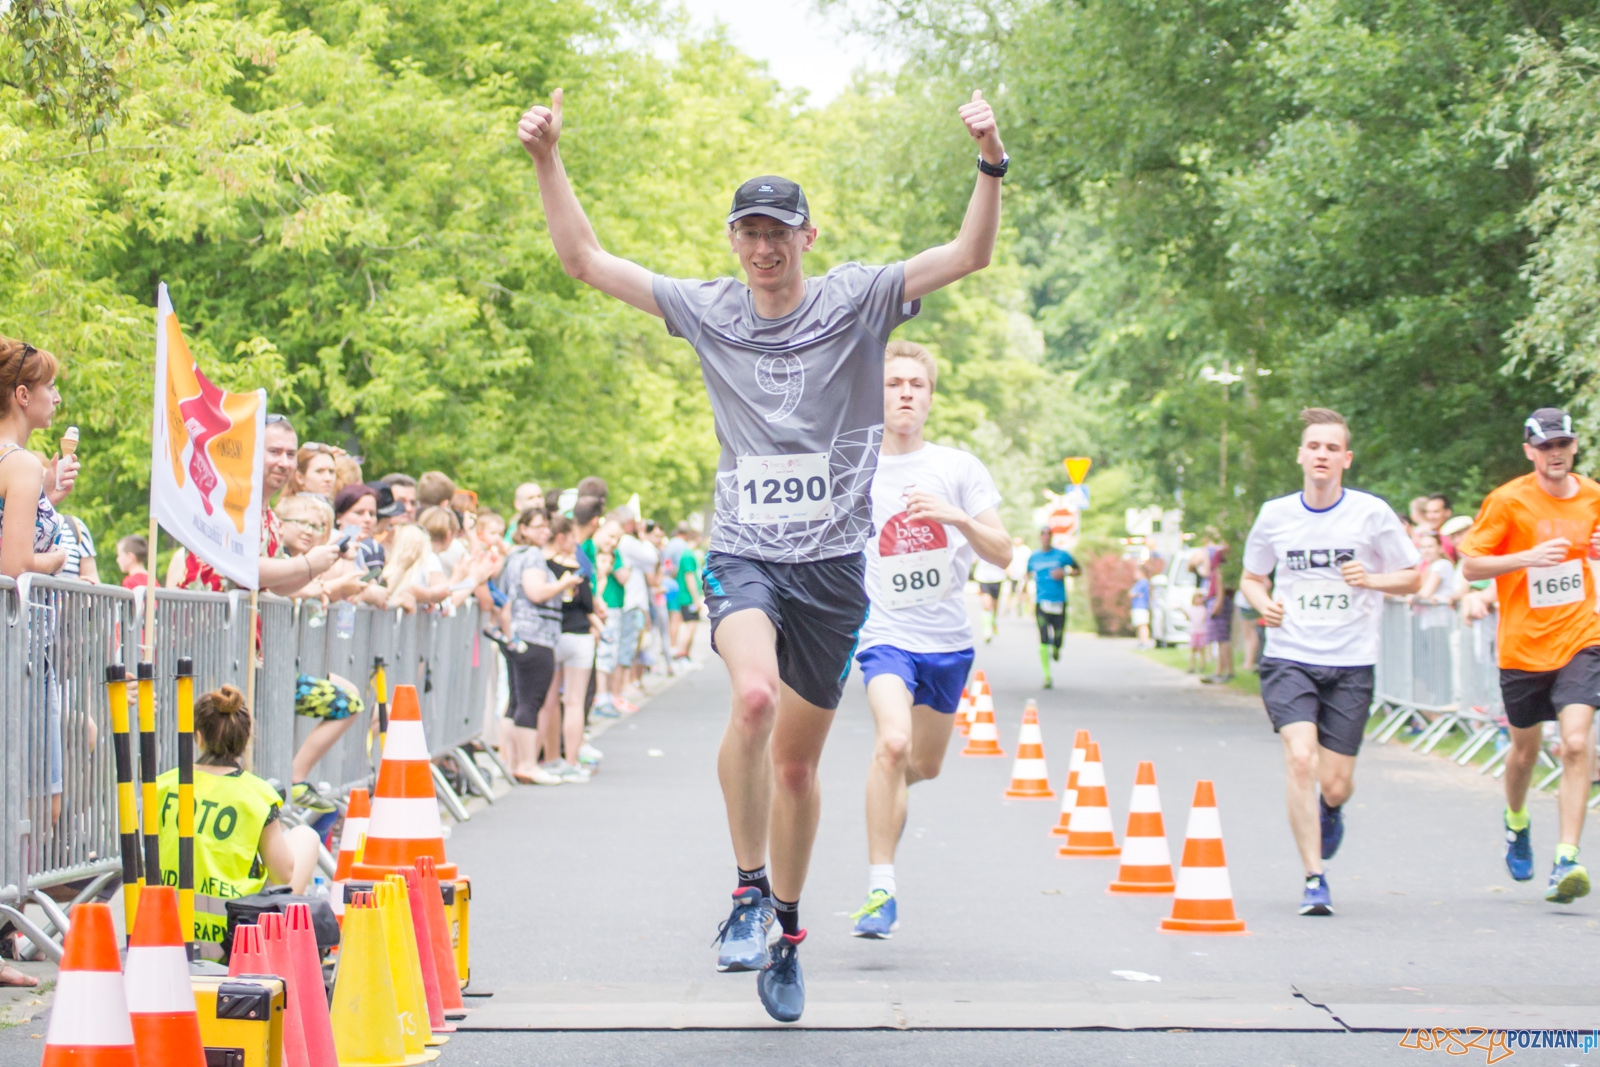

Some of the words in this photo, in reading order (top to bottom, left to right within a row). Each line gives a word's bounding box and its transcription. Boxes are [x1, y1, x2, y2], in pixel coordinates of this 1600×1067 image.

[755, 350, 805, 423] 9
[743, 475, 827, 504] 1290
[894, 521, 934, 543] bieg
[892, 568, 940, 592] 980
[1532, 573, 1581, 595] 1666
[1297, 594, 1349, 610] 1473
